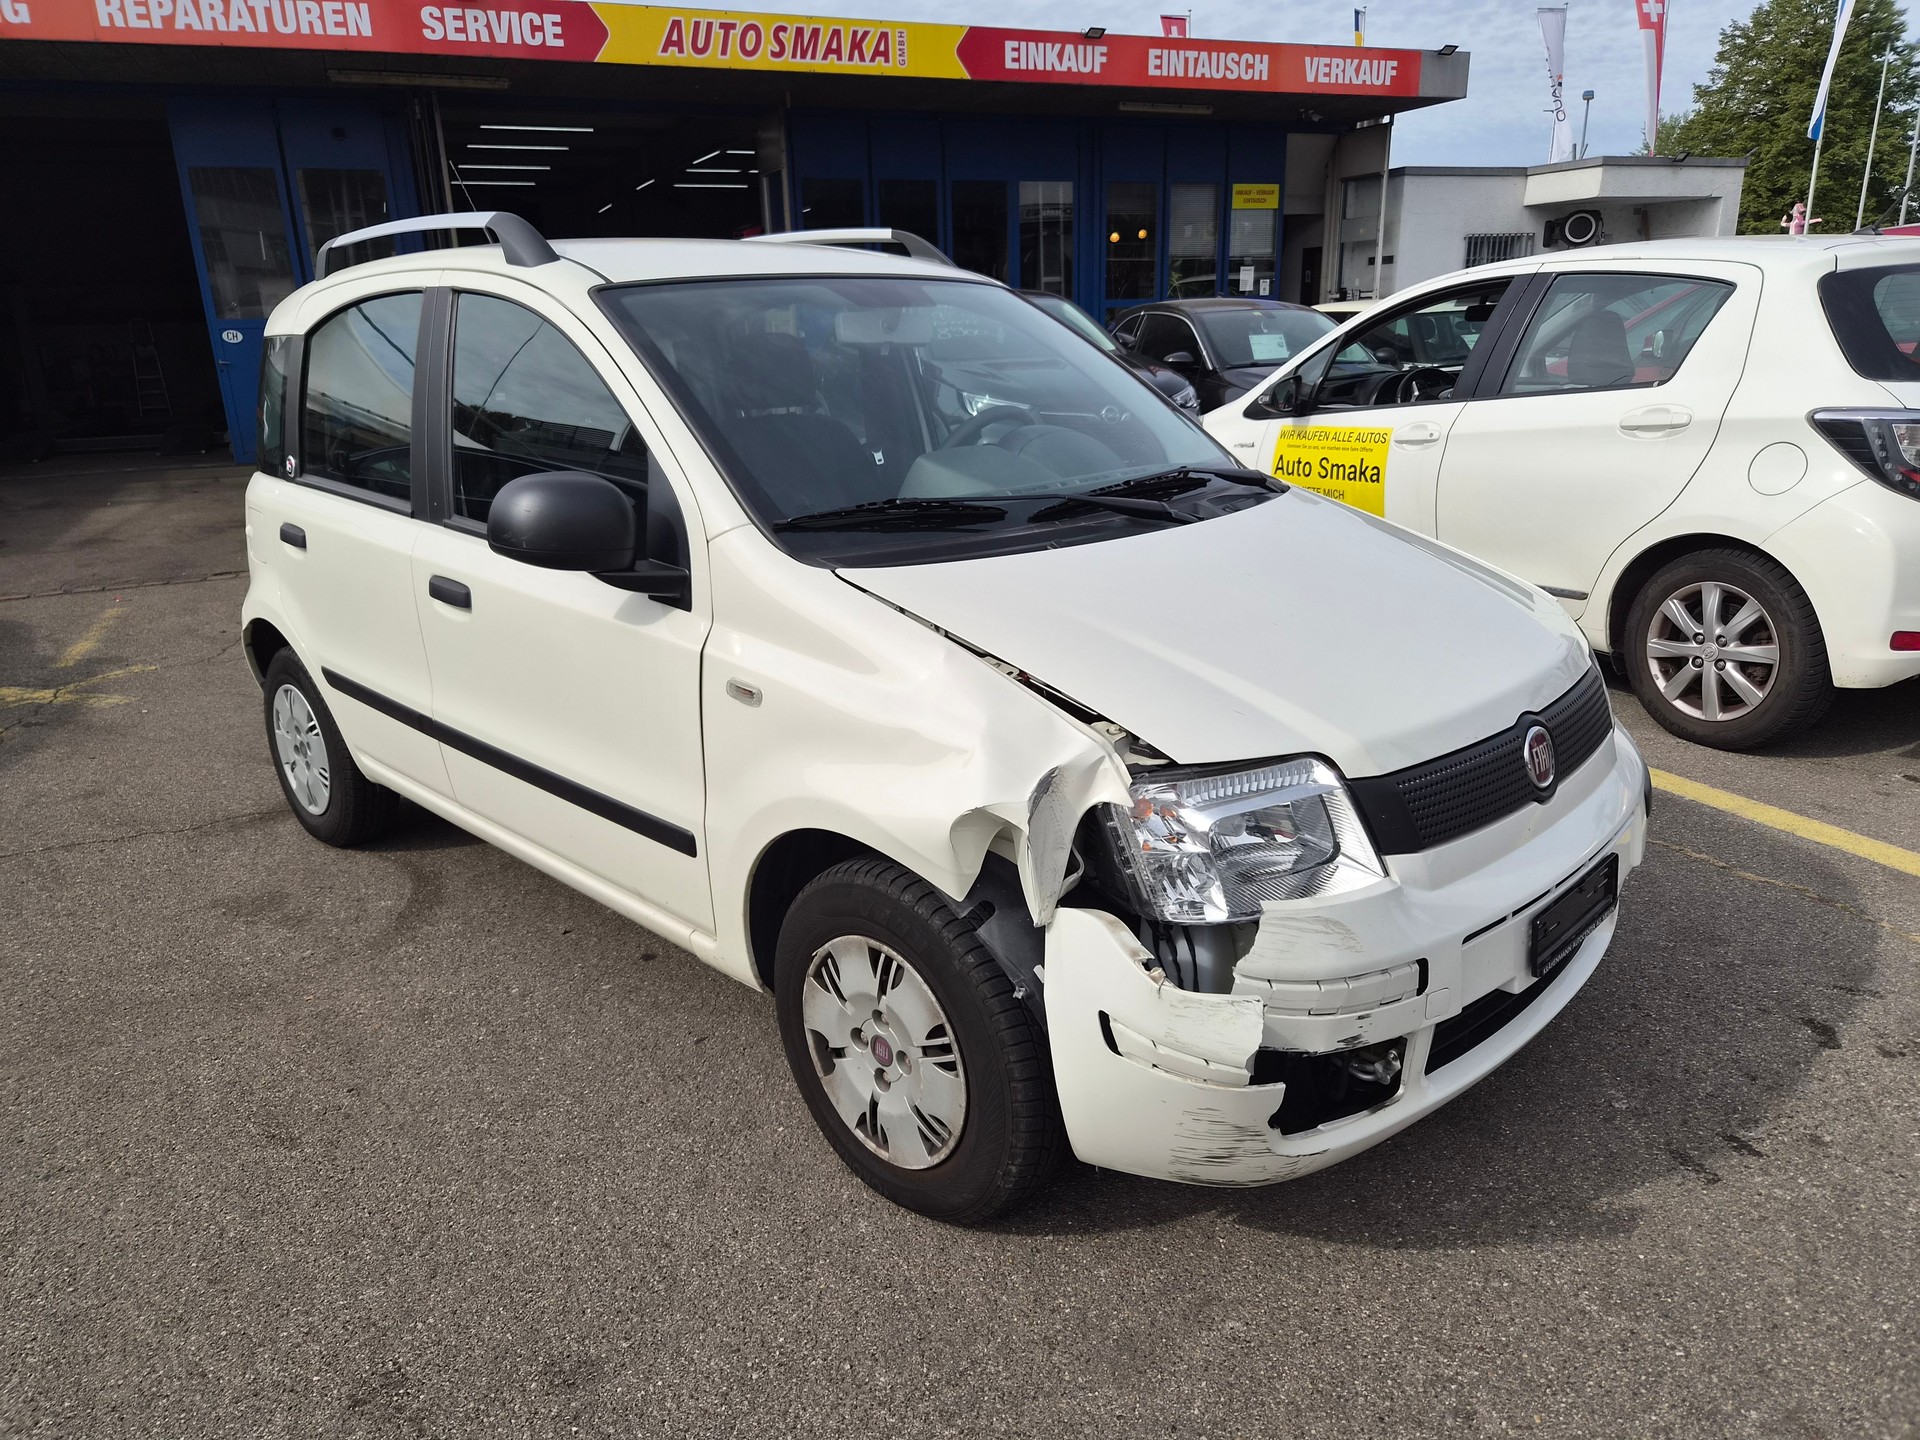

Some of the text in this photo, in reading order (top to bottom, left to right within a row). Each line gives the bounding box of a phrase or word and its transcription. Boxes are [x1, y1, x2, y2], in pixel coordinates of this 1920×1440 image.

[98, 0, 373, 37] REPARATUREN
[421, 6, 565, 47] SERVICE
[659, 17, 893, 66] AUTO SMAKA
[896, 30, 908, 67] GMBH
[1004, 40, 1107, 74] EINKAUF
[1148, 48, 1269, 81] EINTAUSCH
[1304, 56, 1398, 87] VERKAUF
[226, 331, 239, 341] CH
[1279, 429, 1388, 444] WIR KAUFEN ALLE AUTOS
[1274, 454, 1381, 484] Auto Smaka
[1323, 488, 1345, 500] MICH
[1532, 741, 1551, 775] FIAT
[875, 1042, 889, 1060] FIAT
